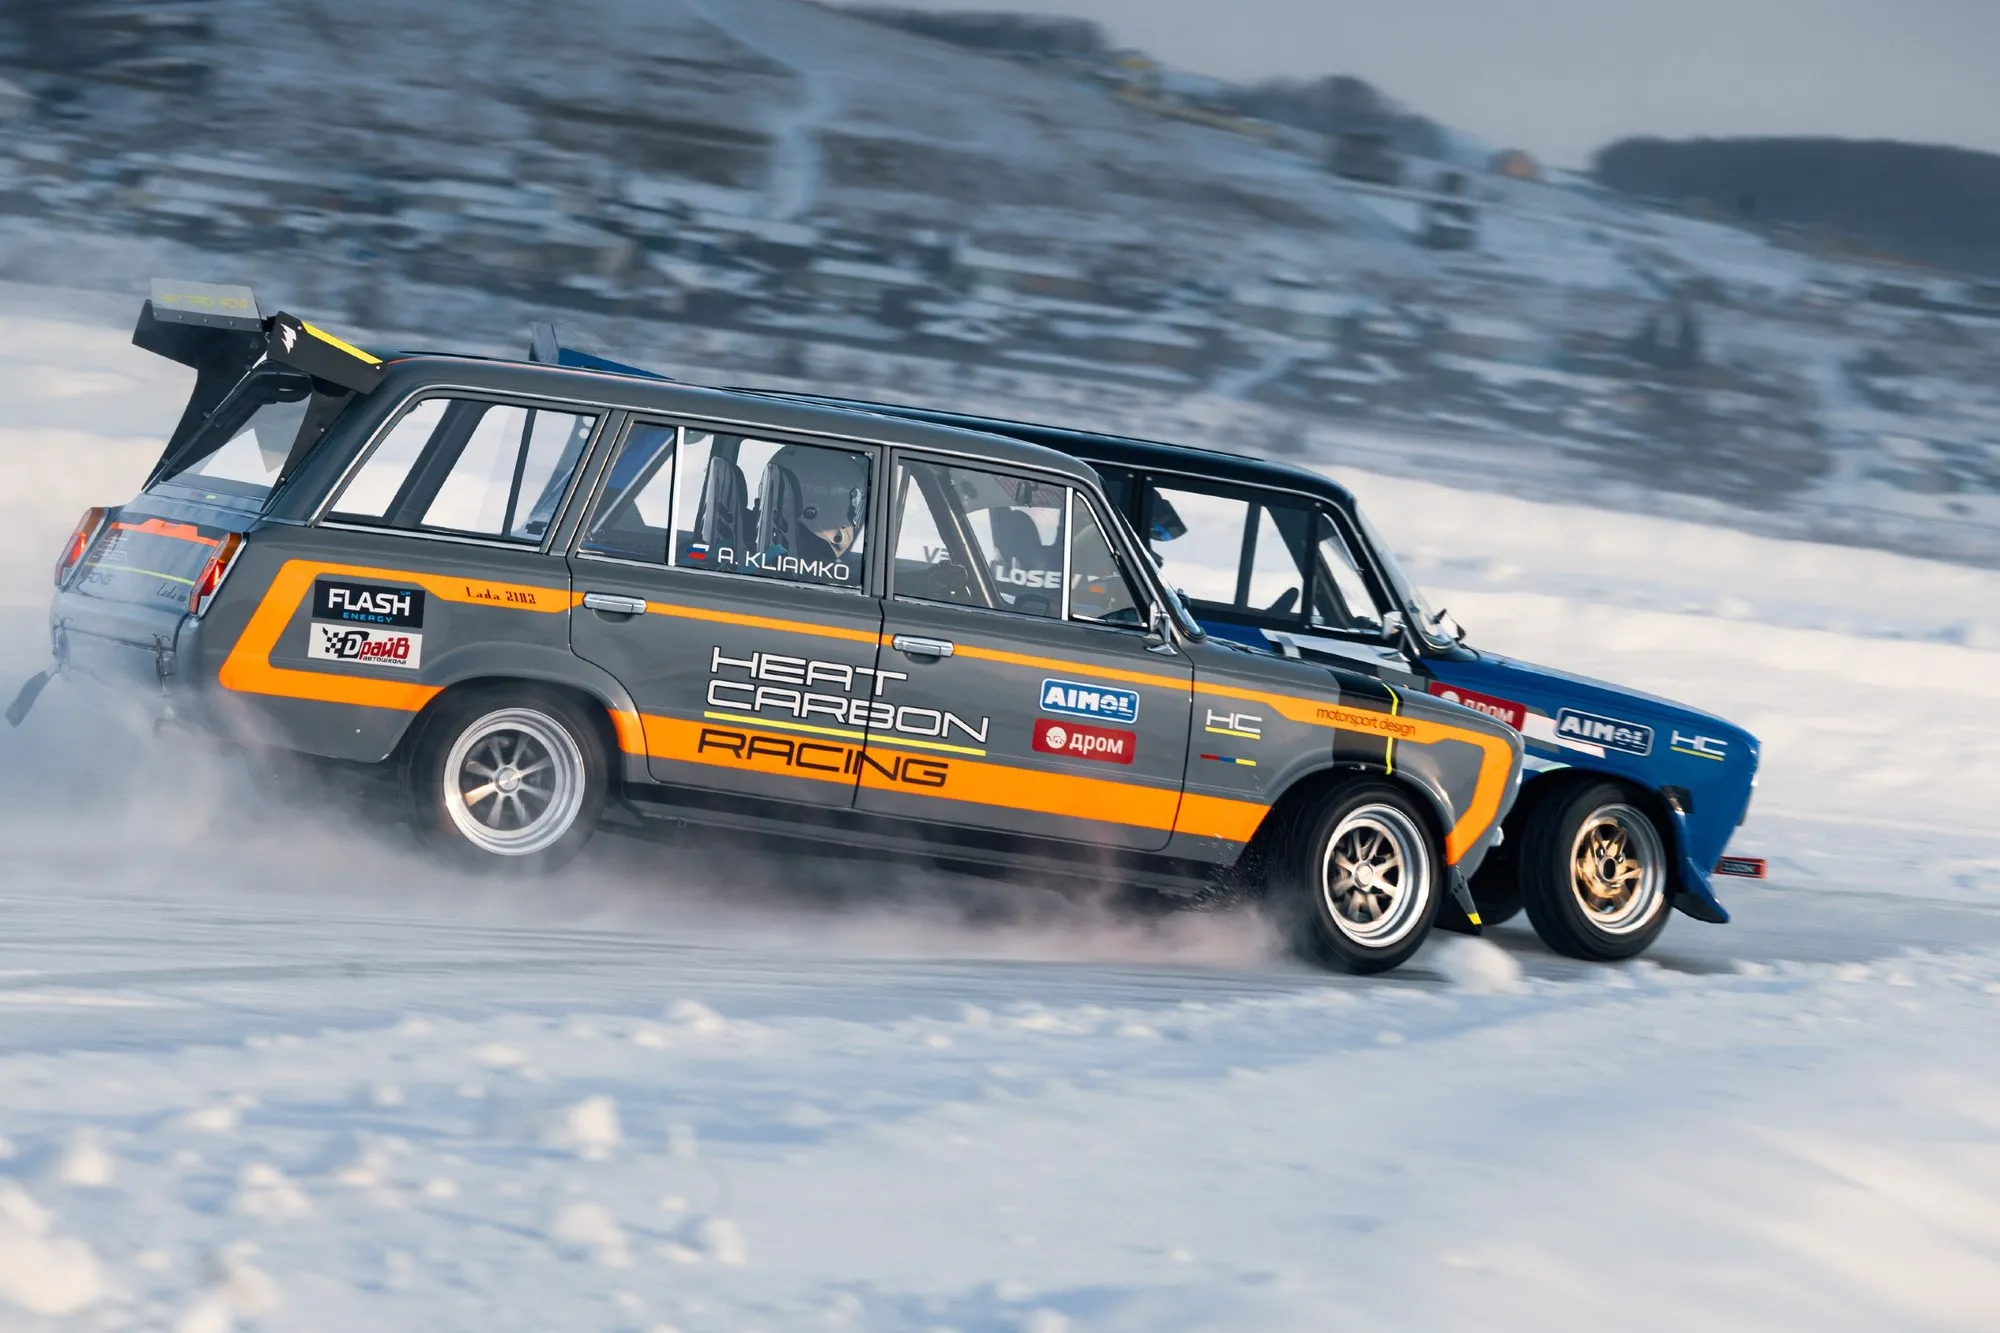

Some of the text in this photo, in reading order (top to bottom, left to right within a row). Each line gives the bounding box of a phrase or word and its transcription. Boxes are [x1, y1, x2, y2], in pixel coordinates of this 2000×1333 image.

[717, 546, 850, 581] A. KLIAMKO
[328, 588, 411, 616] FLASH
[465, 586, 501, 601] Lada
[342, 612, 393, 623] ENERGY
[362, 656, 407, 665] автошкола
[710, 645, 908, 697] HEAT
[706, 678, 990, 744] CARBON
[1044, 686, 1134, 717] AIMOL
[1206, 708, 1264, 734] HC
[1316, 706, 1416, 737] motorsport design
[1559, 715, 1649, 749] AIMOL
[696, 727, 950, 788] RACING
[1069, 733, 1124, 755] дром
[1671, 730, 1729, 757] HC
